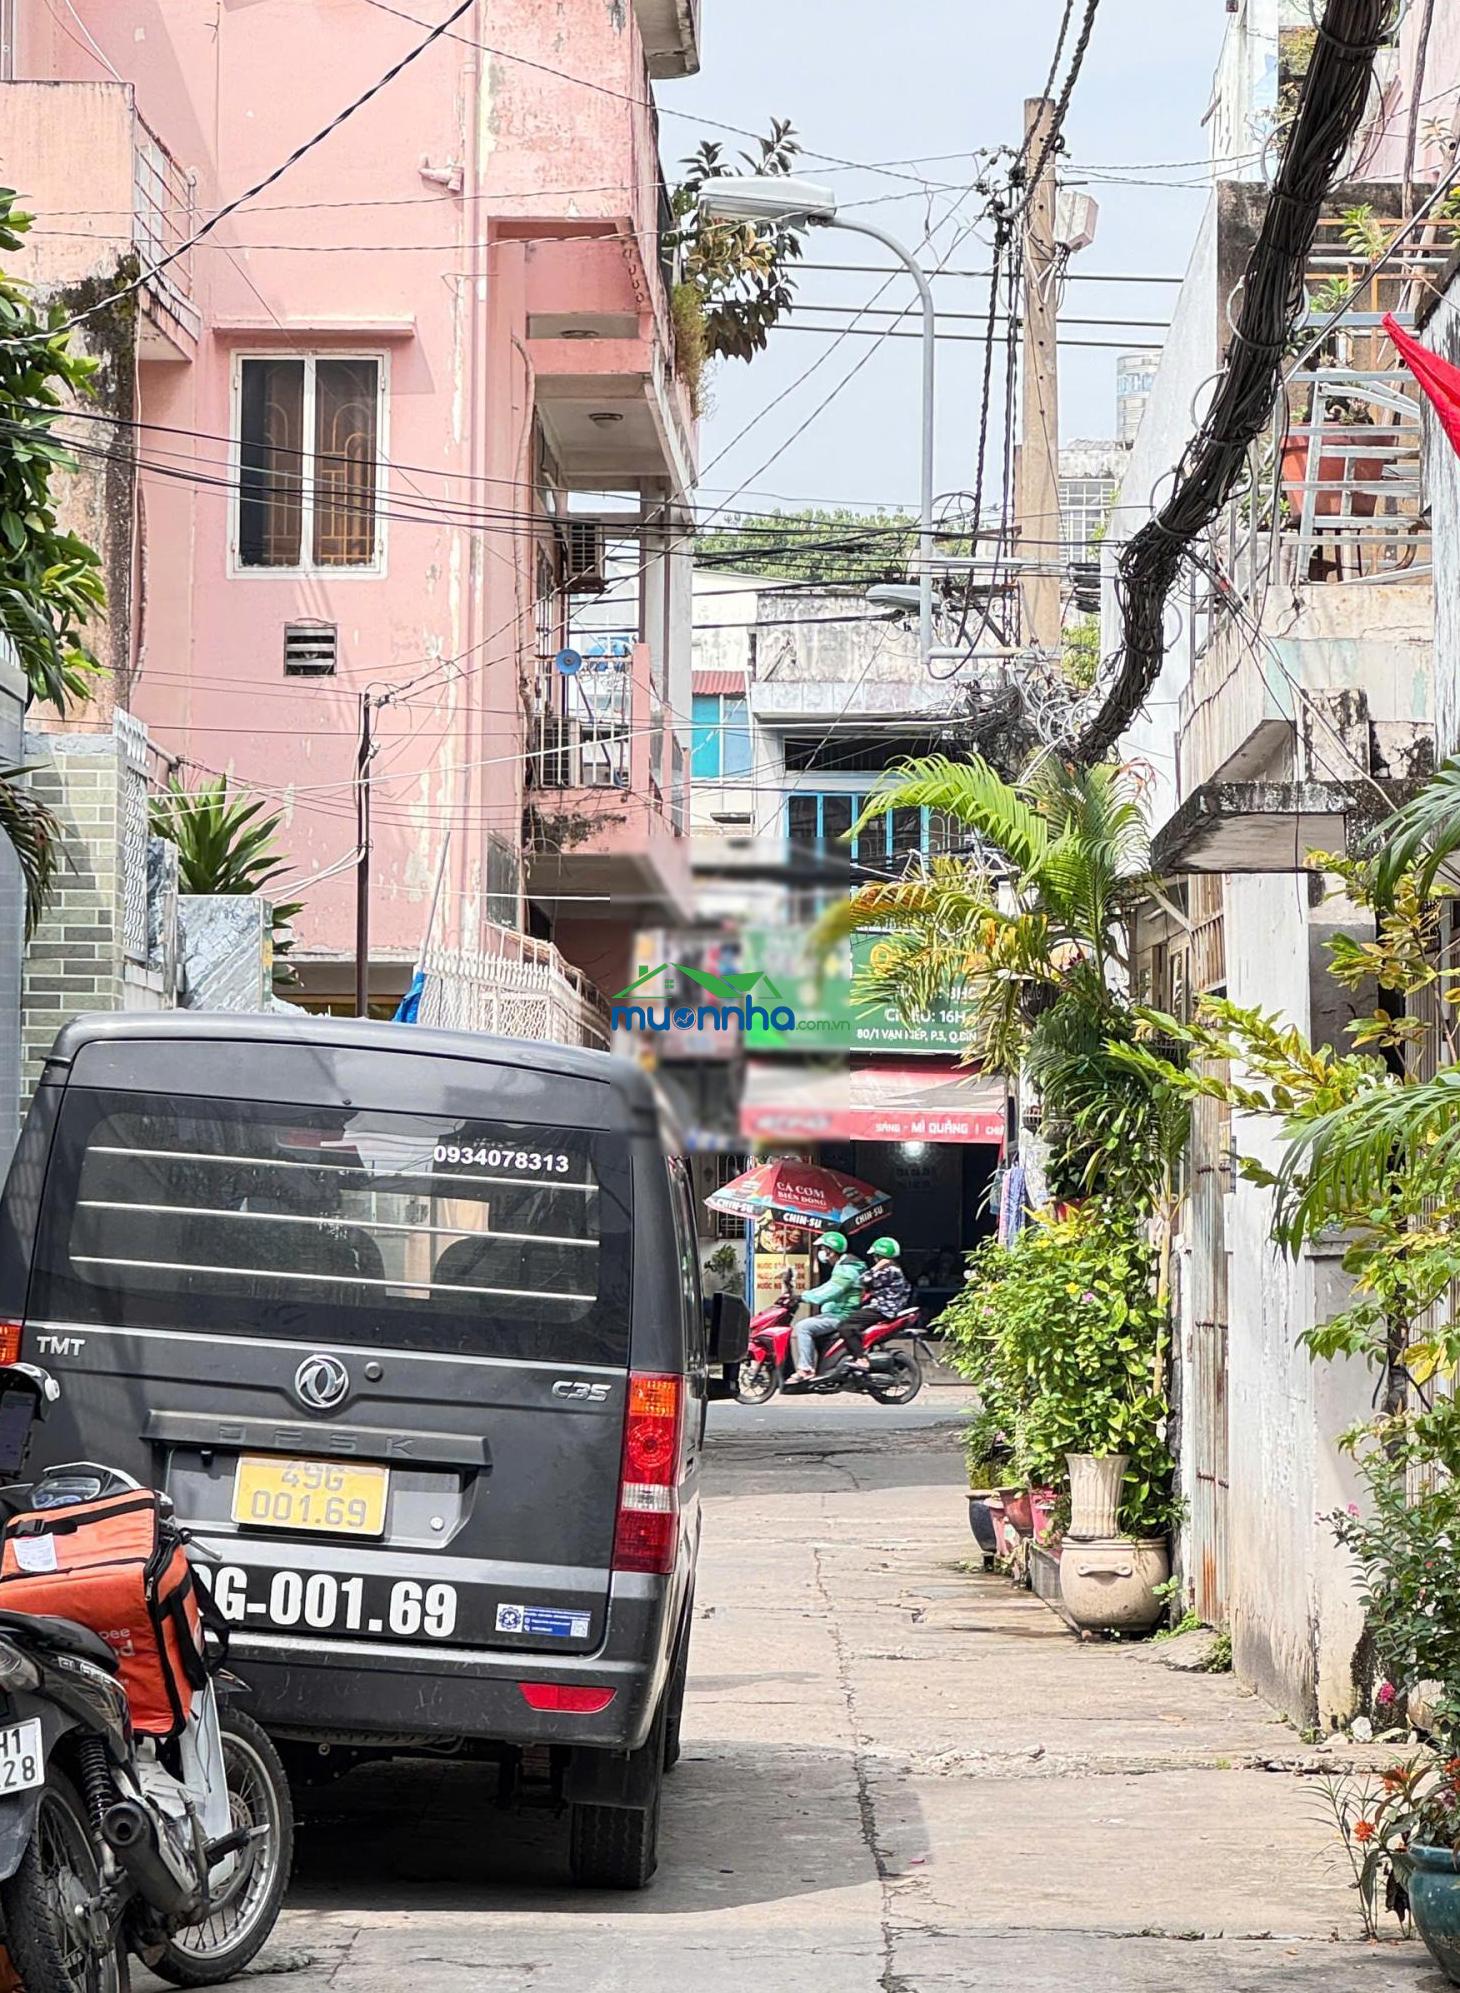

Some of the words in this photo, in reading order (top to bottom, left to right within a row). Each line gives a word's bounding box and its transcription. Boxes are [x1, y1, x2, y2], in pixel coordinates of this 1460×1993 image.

[856, 1028, 880, 1041] 80/1
[928, 1120, 969, 1135] QUẢNG
[433, 1145, 569, 1173] 0934078313
[783, 1212, 823, 1228] CHIN-SU
[855, 1205, 883, 1225] CHIN-SU
[36, 1336, 86, 1356] TMT
[219, 1423, 415, 1456] DFSK
[281, 1459, 345, 1492] 49G
[251, 1490, 367, 1528] 001.69
